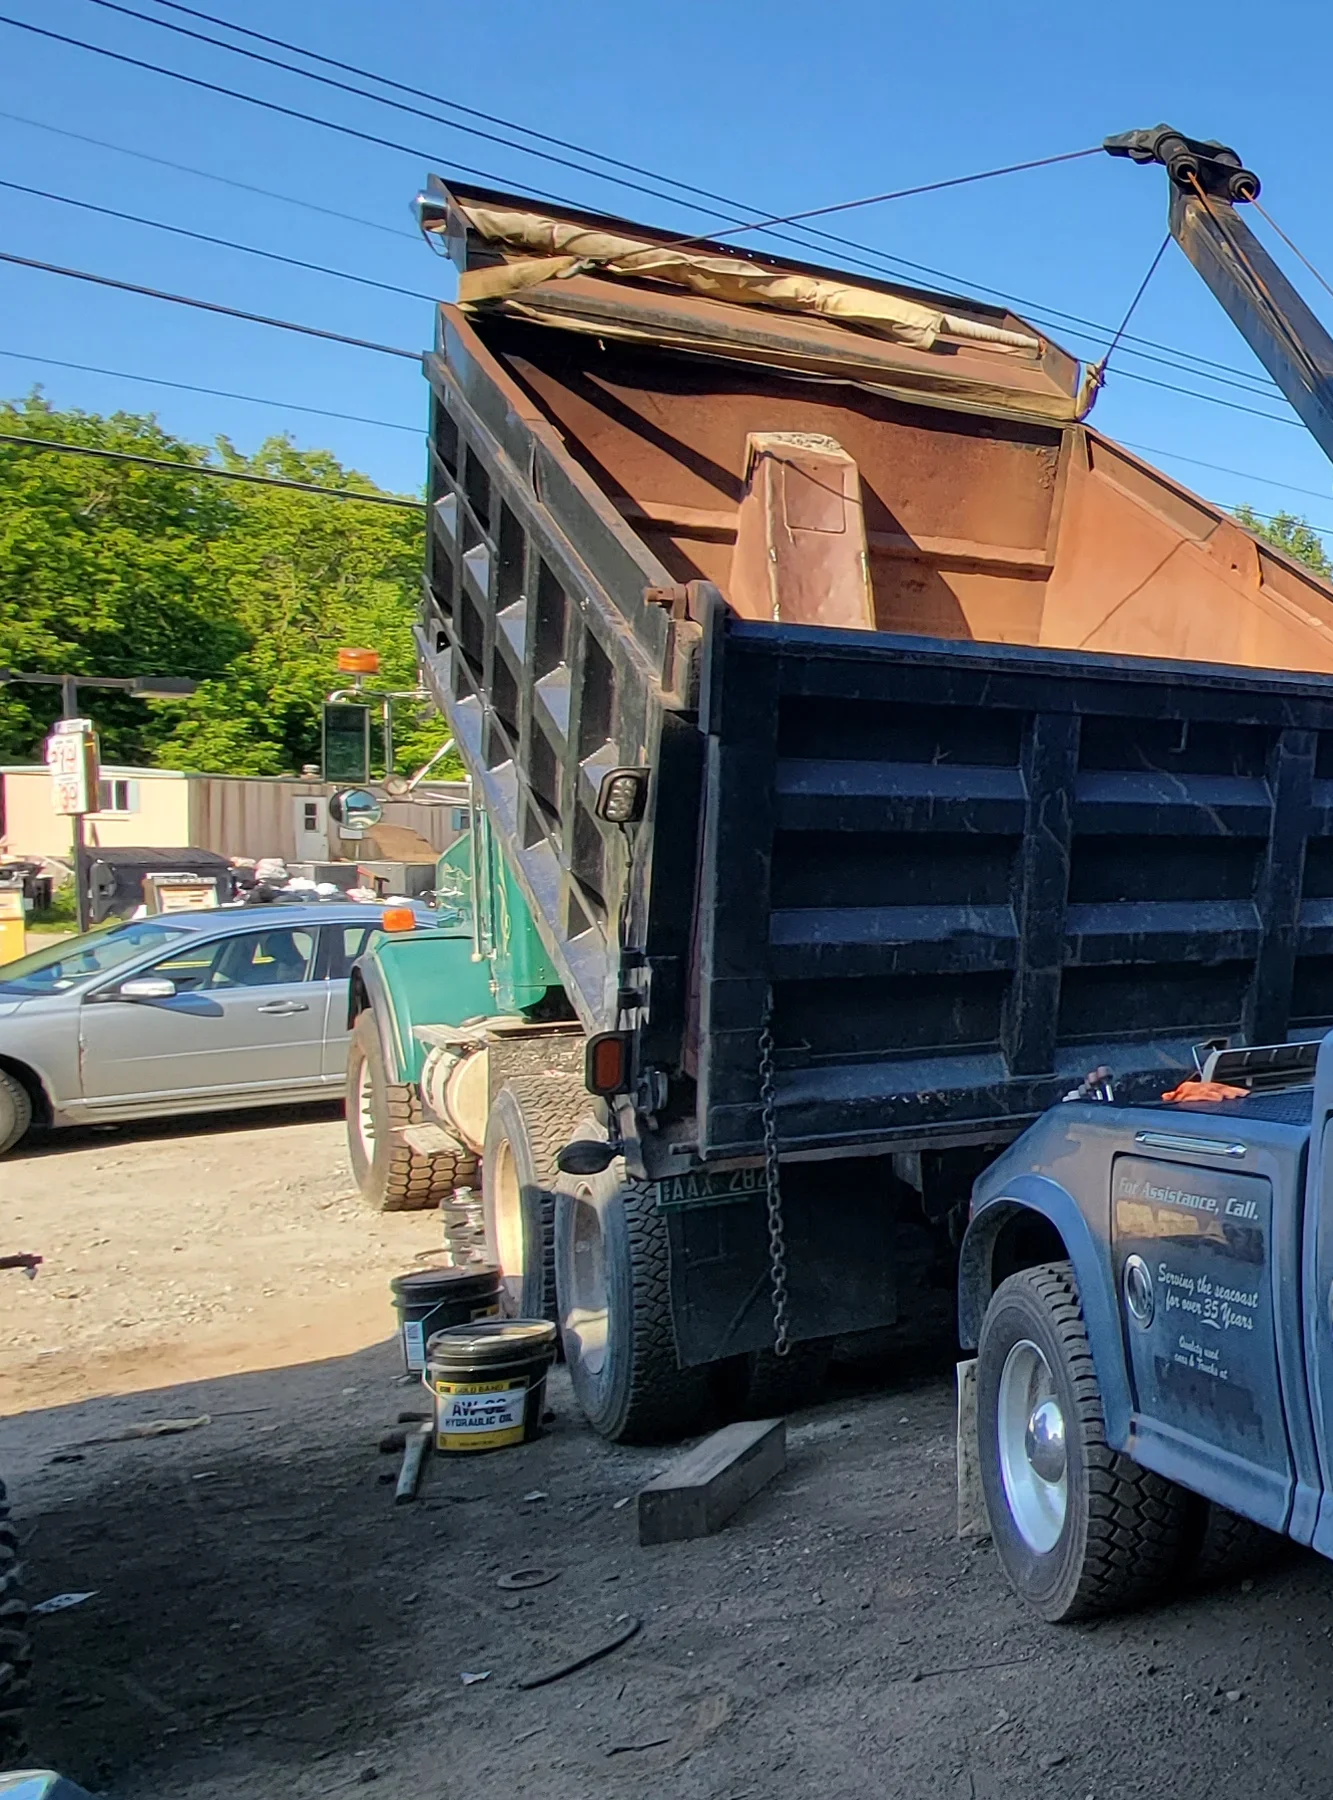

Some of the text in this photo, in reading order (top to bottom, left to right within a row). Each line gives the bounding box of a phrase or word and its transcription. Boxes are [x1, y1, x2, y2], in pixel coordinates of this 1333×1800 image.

[1119, 1177, 1258, 1220] For Assistance, Call.
[1157, 1263, 1258, 1308] Serving the seacoast
[1166, 1289, 1253, 1330] for over 35 Years
[445, 1413, 513, 1427] HYDRAULIC OIL
